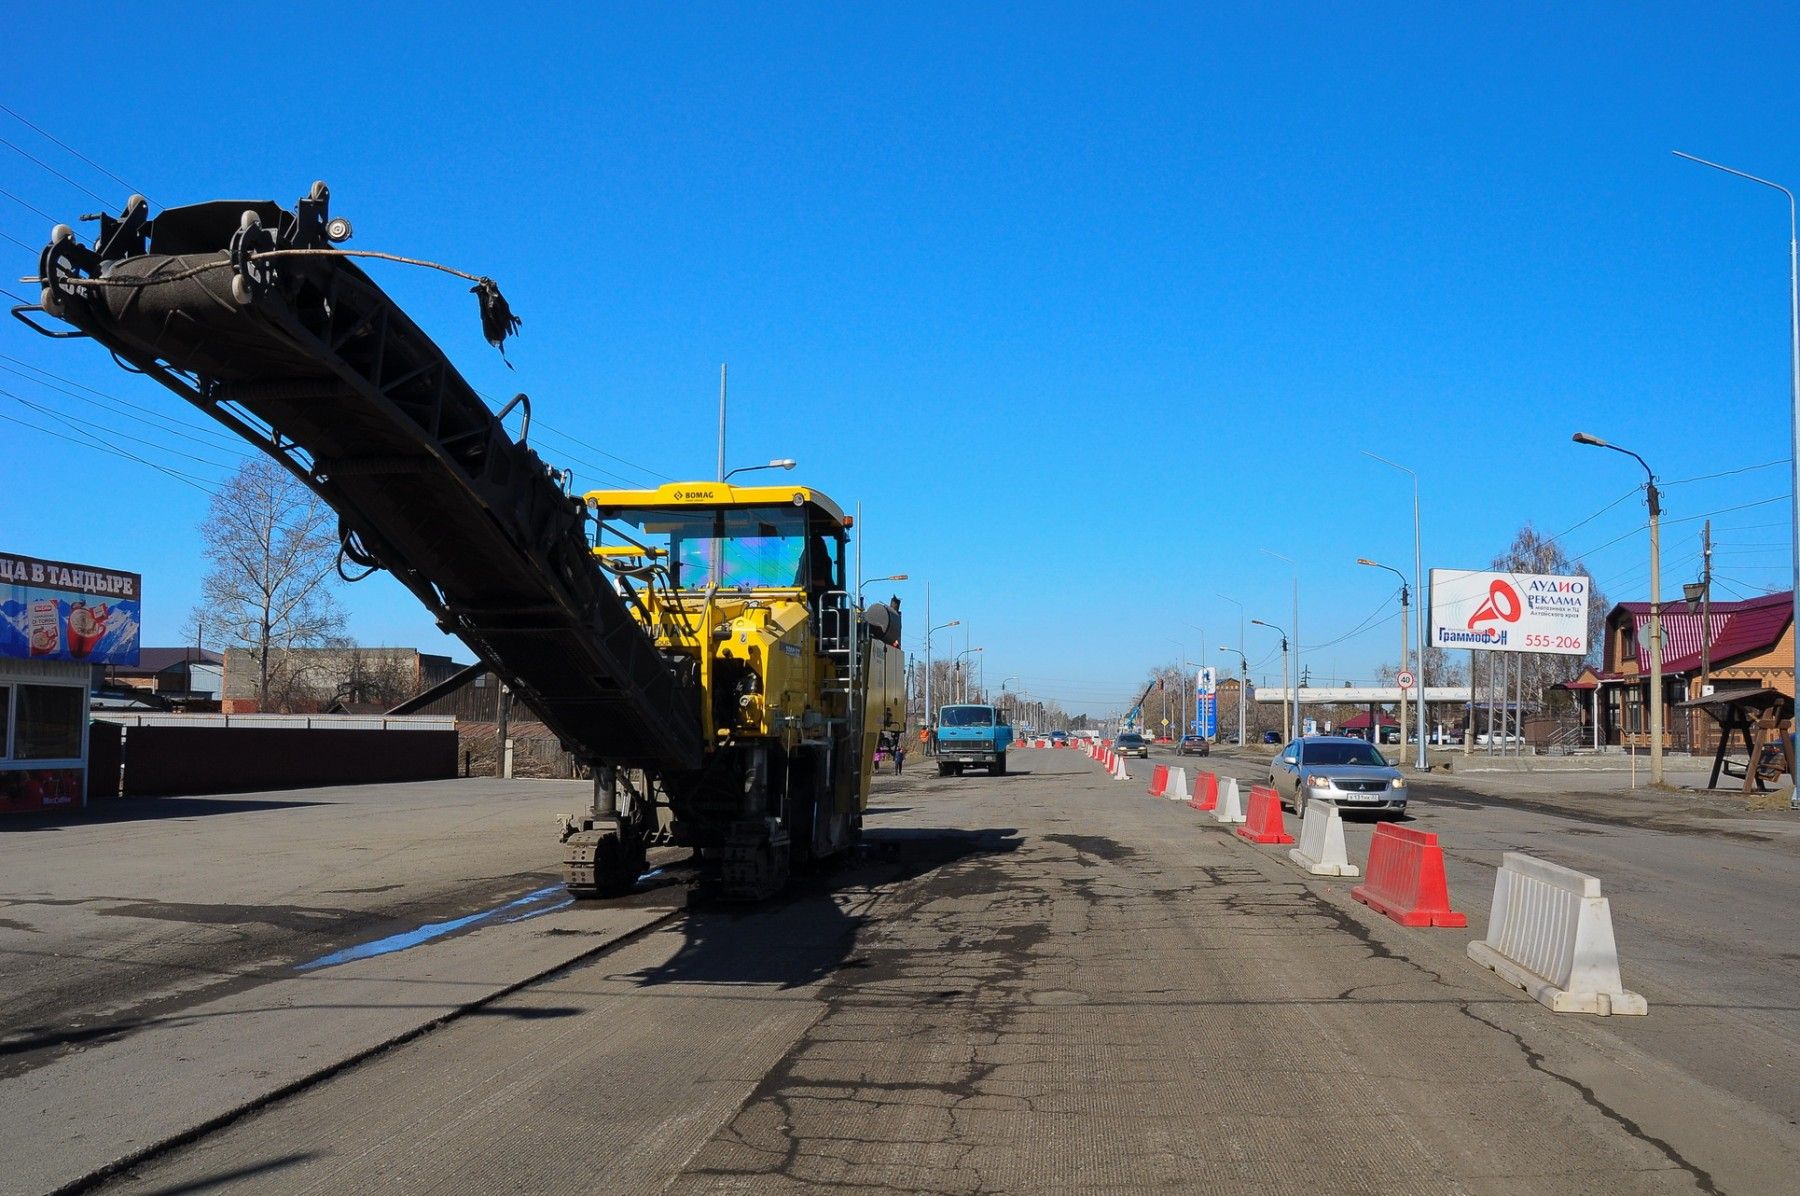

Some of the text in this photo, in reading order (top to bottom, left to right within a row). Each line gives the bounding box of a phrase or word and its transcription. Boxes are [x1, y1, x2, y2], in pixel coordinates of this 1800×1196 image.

[685, 491, 714, 499] BOMAG
[31, 563, 45, 582] В
[47, 566, 133, 595] ТАНДЫРЕ
[1529, 580, 1584, 594] АУДИО
[1528, 595, 1582, 607] РЕКЛАМА
[1525, 634, 1581, 649] 555-206
[1400, 676, 1411, 684] 40
